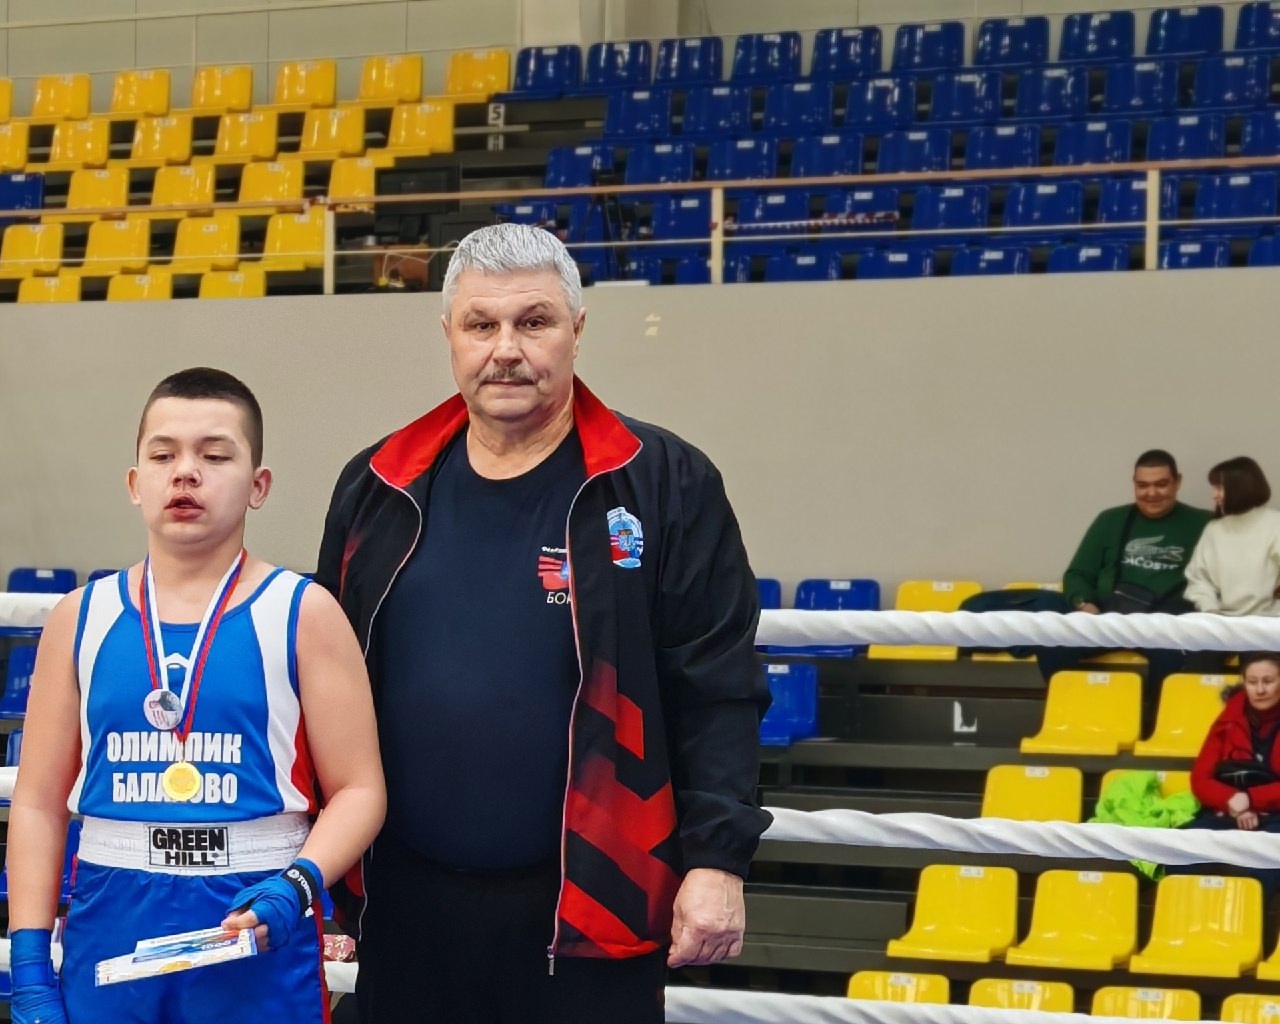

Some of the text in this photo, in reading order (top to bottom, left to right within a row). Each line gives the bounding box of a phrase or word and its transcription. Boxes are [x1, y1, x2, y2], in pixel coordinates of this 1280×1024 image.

[107, 731, 242, 763] ОЛИМПИК
[112, 772, 238, 804] БАЛАВО
[152, 828, 226, 851] GREEN
[164, 851, 215, 866] HILL
